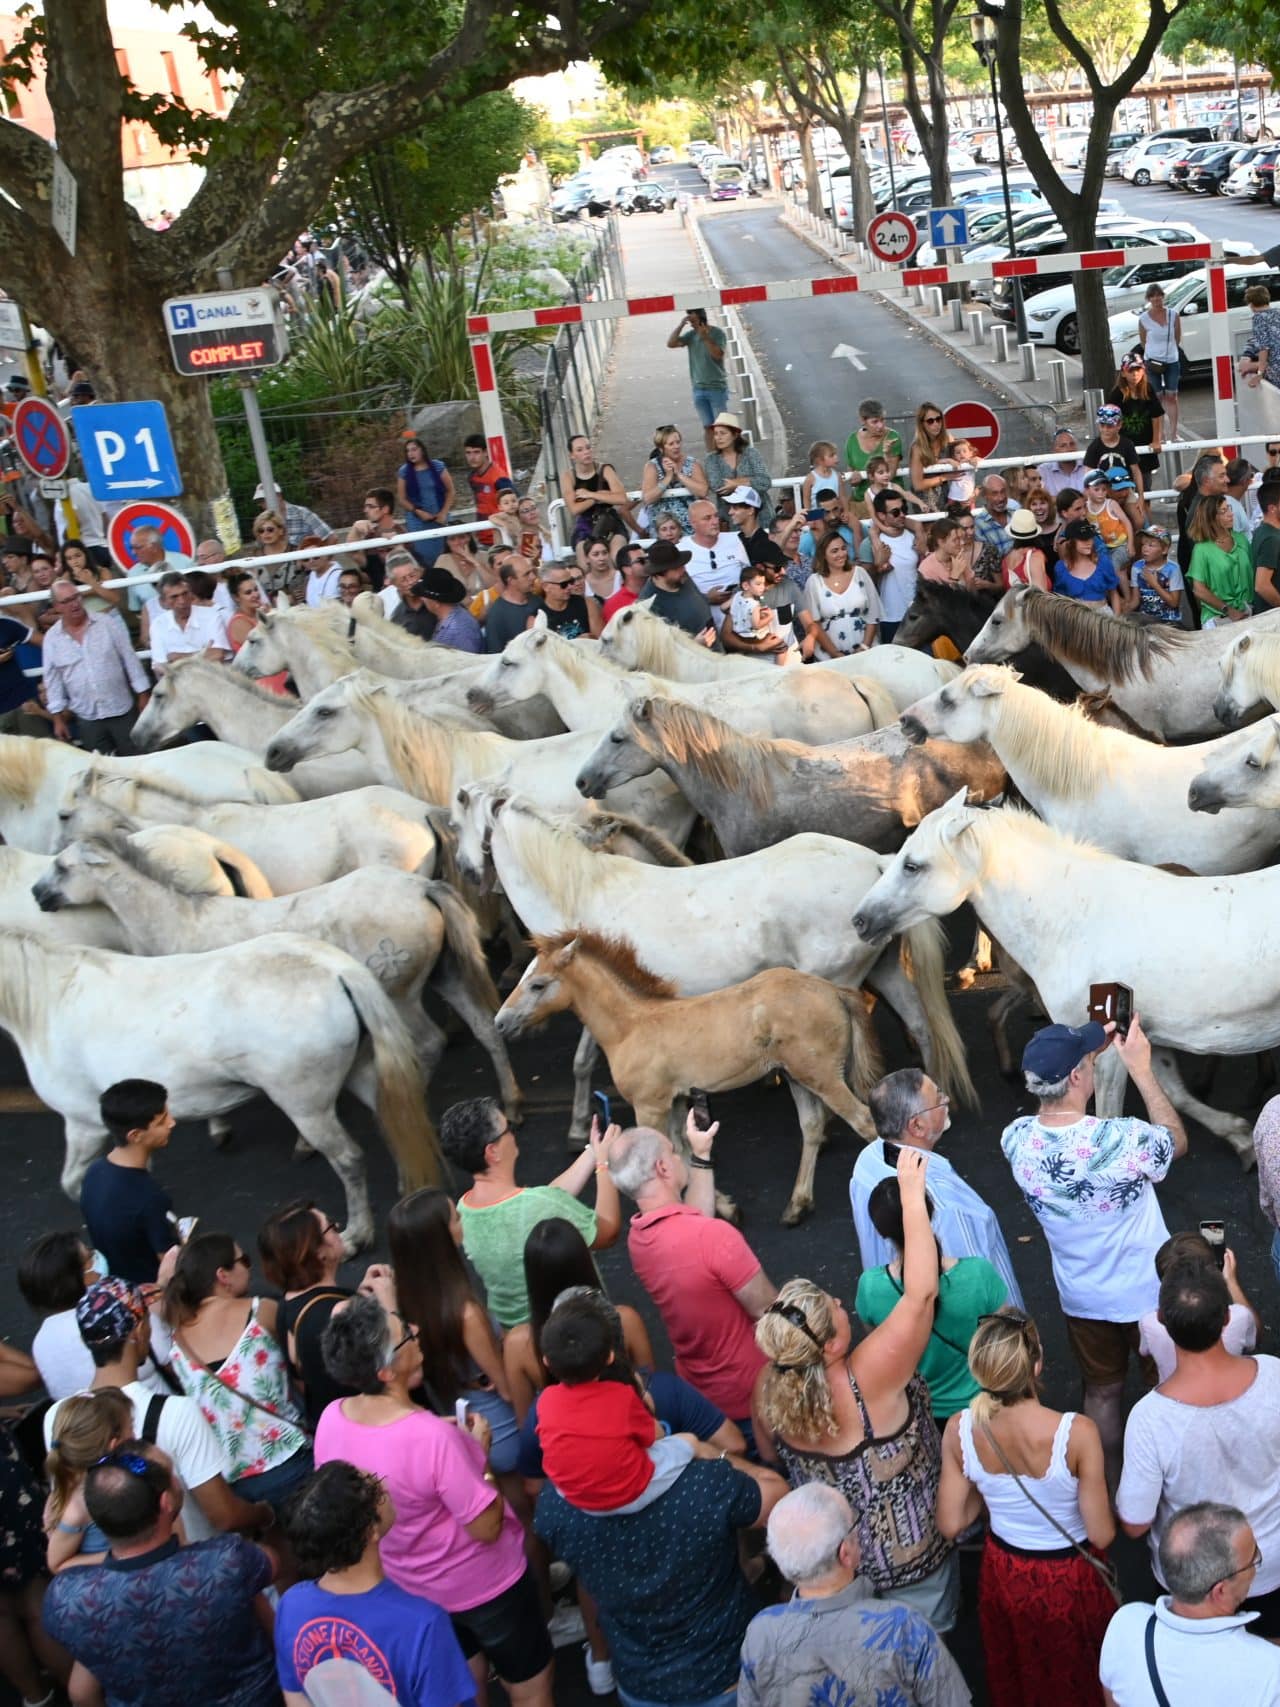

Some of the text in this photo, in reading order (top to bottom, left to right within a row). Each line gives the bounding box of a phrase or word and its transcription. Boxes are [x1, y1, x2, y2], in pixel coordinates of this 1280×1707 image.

[876, 232, 908, 246] 2,4m
[196, 305, 242, 320] CANAL
[190, 341, 264, 366] COMPLET
[298, 1624, 384, 1679] STONE ISLAND
